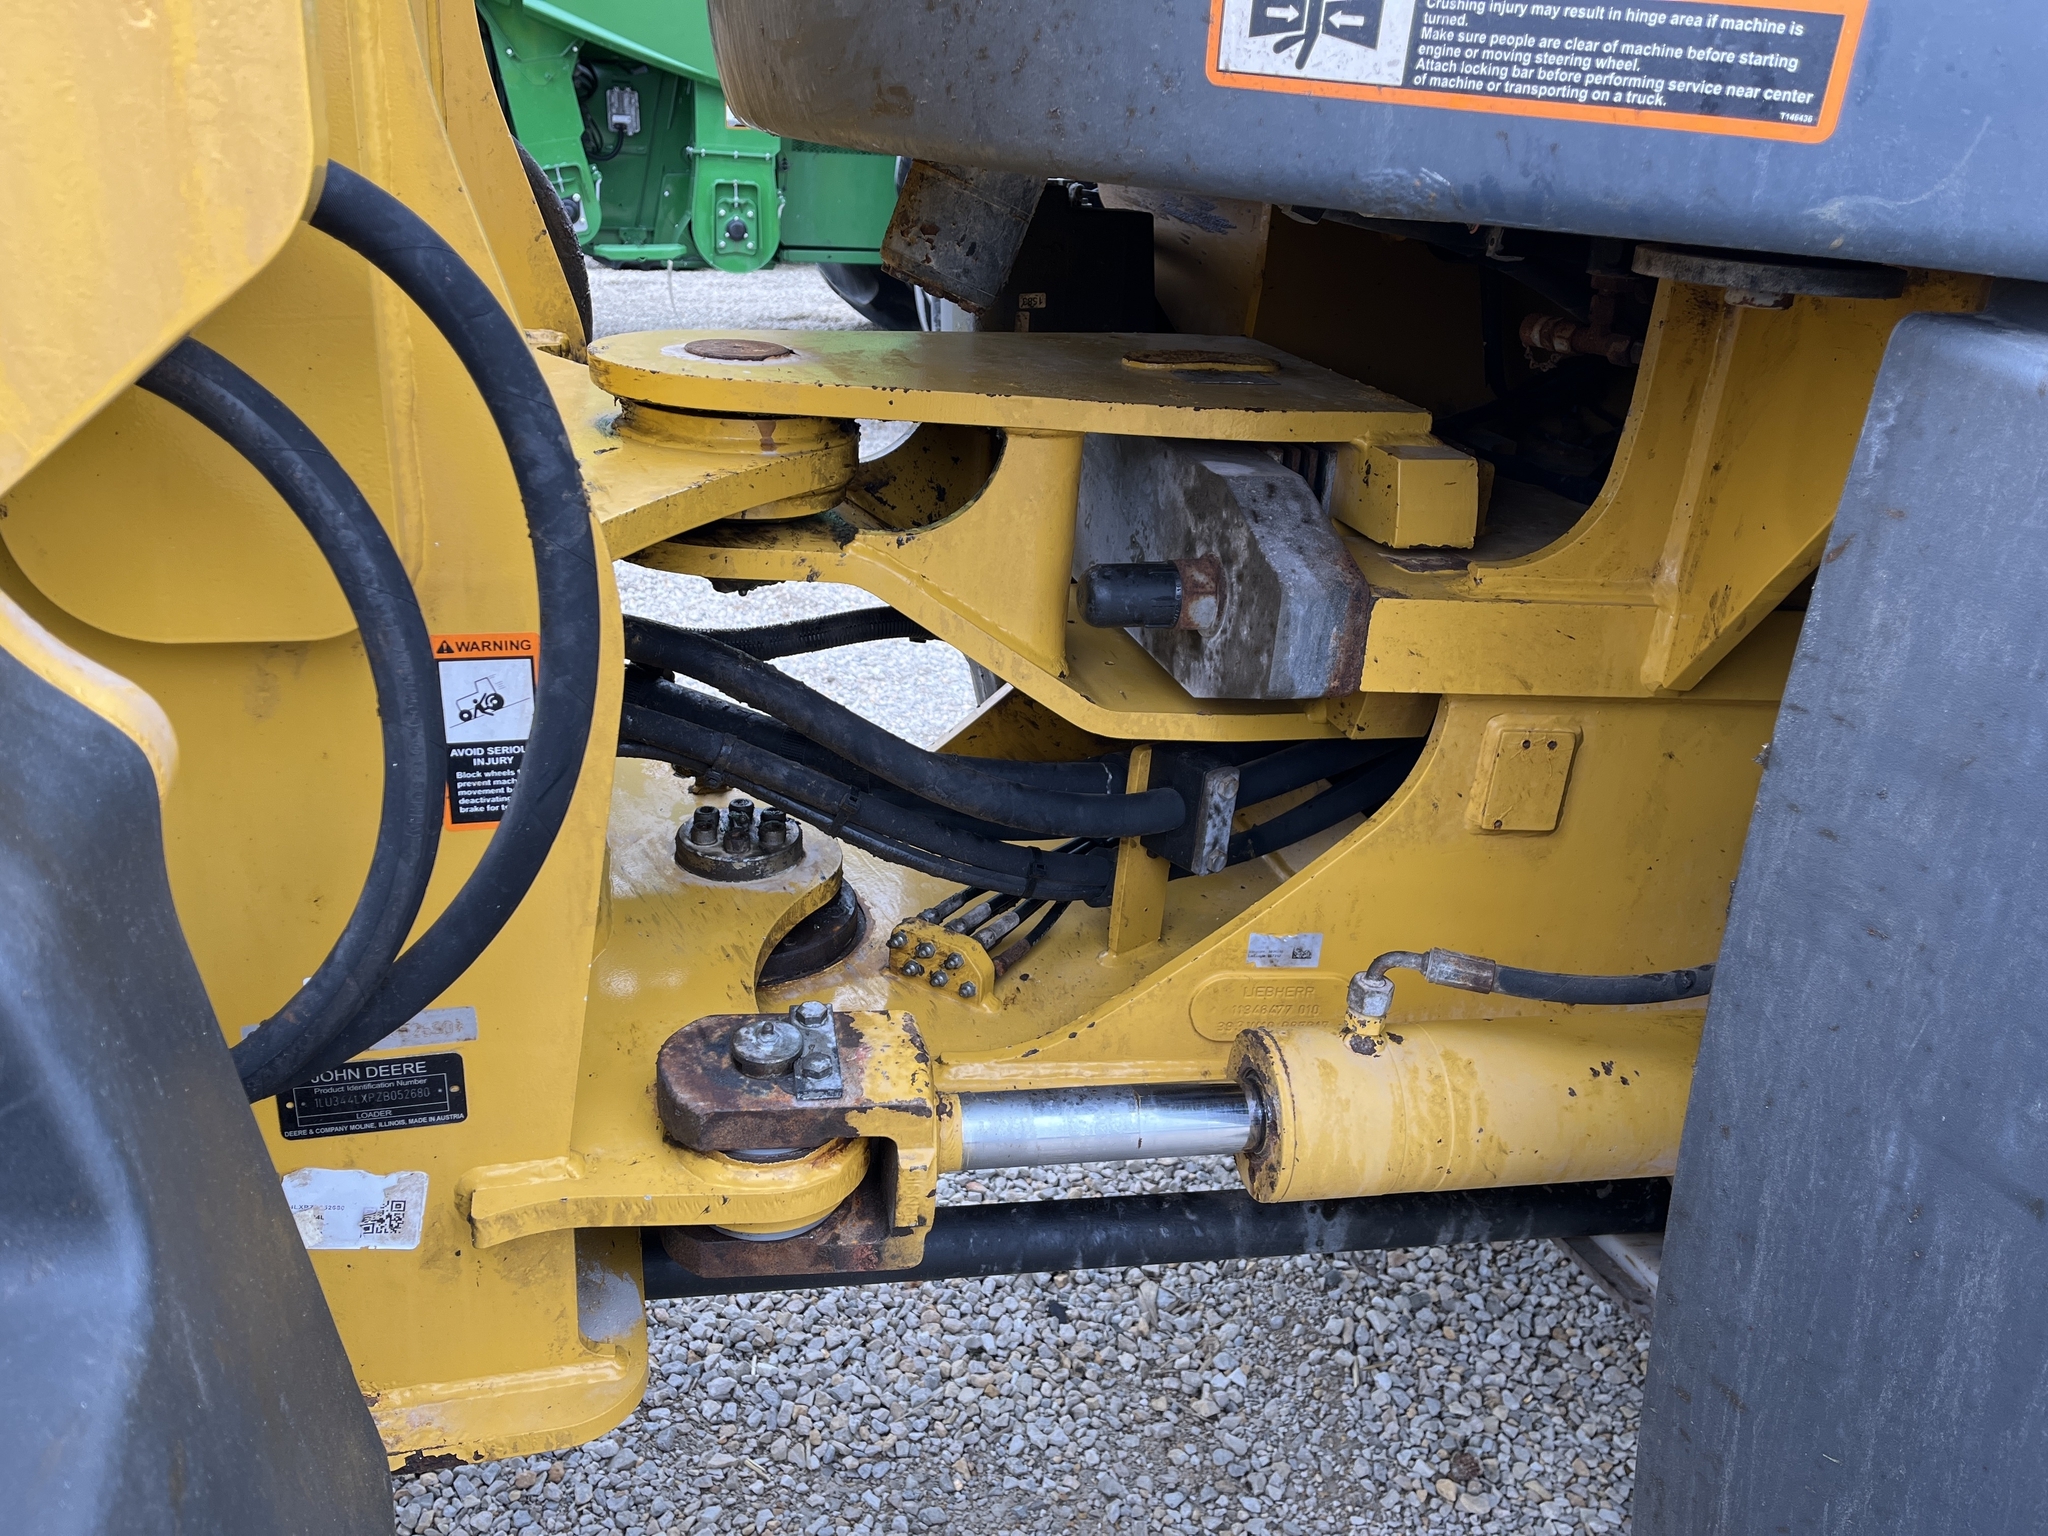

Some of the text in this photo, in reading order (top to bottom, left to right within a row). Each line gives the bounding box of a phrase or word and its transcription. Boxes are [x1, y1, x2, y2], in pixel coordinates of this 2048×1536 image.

[1423, 12, 1469, 27] turned.
[1426, 0, 1804, 36] Crushing injury may result in hinge area if machine is
[1421, 26, 1799, 73] Make sure people are clear of machine before starting
[1418, 44, 1641, 73] engine or moving steering wheel.
[1415, 58, 1814, 105] Attach locking bar before performing service near center
[1413, 73, 1667, 107] of machine or transporting on a truck.
[1780, 112, 1814, 123] T146436
[455, 640, 532, 652] WARNING
[450, 746, 525, 757] AVOID SERIOU
[473, 756, 514, 766] INJURY
[456, 771, 482, 779] Block
[484, 769, 515, 778] wheels
[457, 780, 491, 789] prevent
[458, 787, 505, 796] movement
[1243, 986, 1315, 998] LIEBHERR
[1297, 1004, 1320, 1016] 010
[311, 1061, 427, 1084] JOHN DEERE
[314, 1078, 427, 1094] Product Identification Number
[356, 1110, 392, 1119] LOADER
[284, 1129, 307, 1138] DEERE
[315, 1125, 348, 1135] COMPANY
[350, 1122, 377, 1131] MOLINE,
[408, 1116, 428, 1125] MADE
[436, 1113, 465, 1122] AUSTRIA
